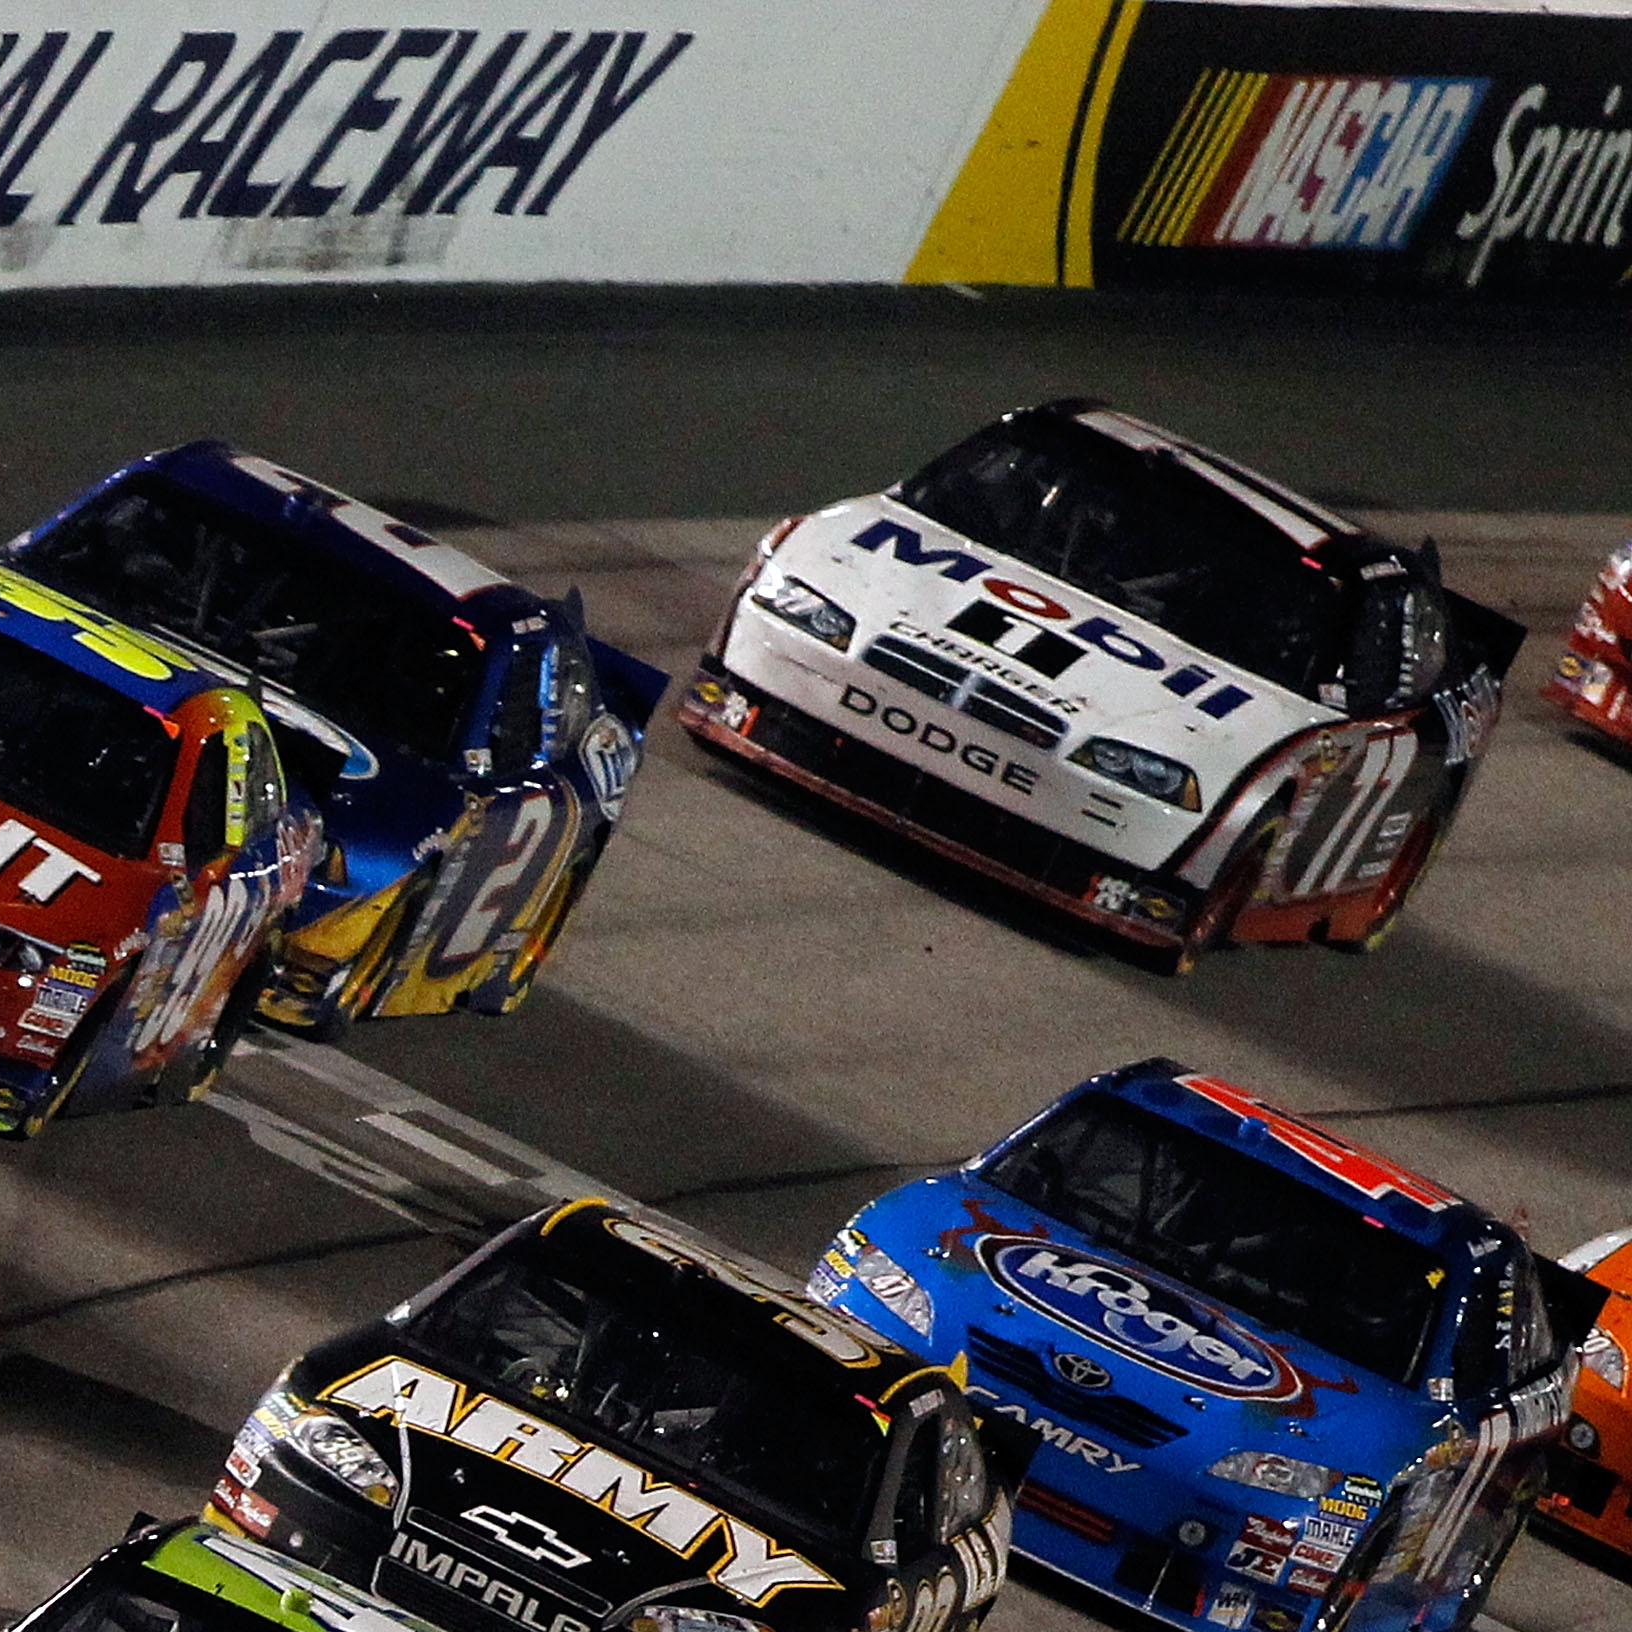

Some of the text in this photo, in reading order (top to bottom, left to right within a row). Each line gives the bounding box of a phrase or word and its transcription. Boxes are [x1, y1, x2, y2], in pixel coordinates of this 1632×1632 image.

[59, 29, 694, 226] RACEWAY
[1214, 81, 1472, 245] NASCAR
[850, 519, 1254, 720] Mobil
[889, 619, 1081, 716] CHARGER
[990, 616, 1044, 655] 1
[839, 685, 1040, 796] DODGE
[441, 792, 553, 960] 2
[1017, 1251, 1271, 1380] Kroger
[316, 1355, 844, 1607] ARMY
[1307, 1518, 1357, 1547] MAHLE
[1320, 1497, 1368, 1520] MOOG
[1228, 1548, 1282, 1577] JE
